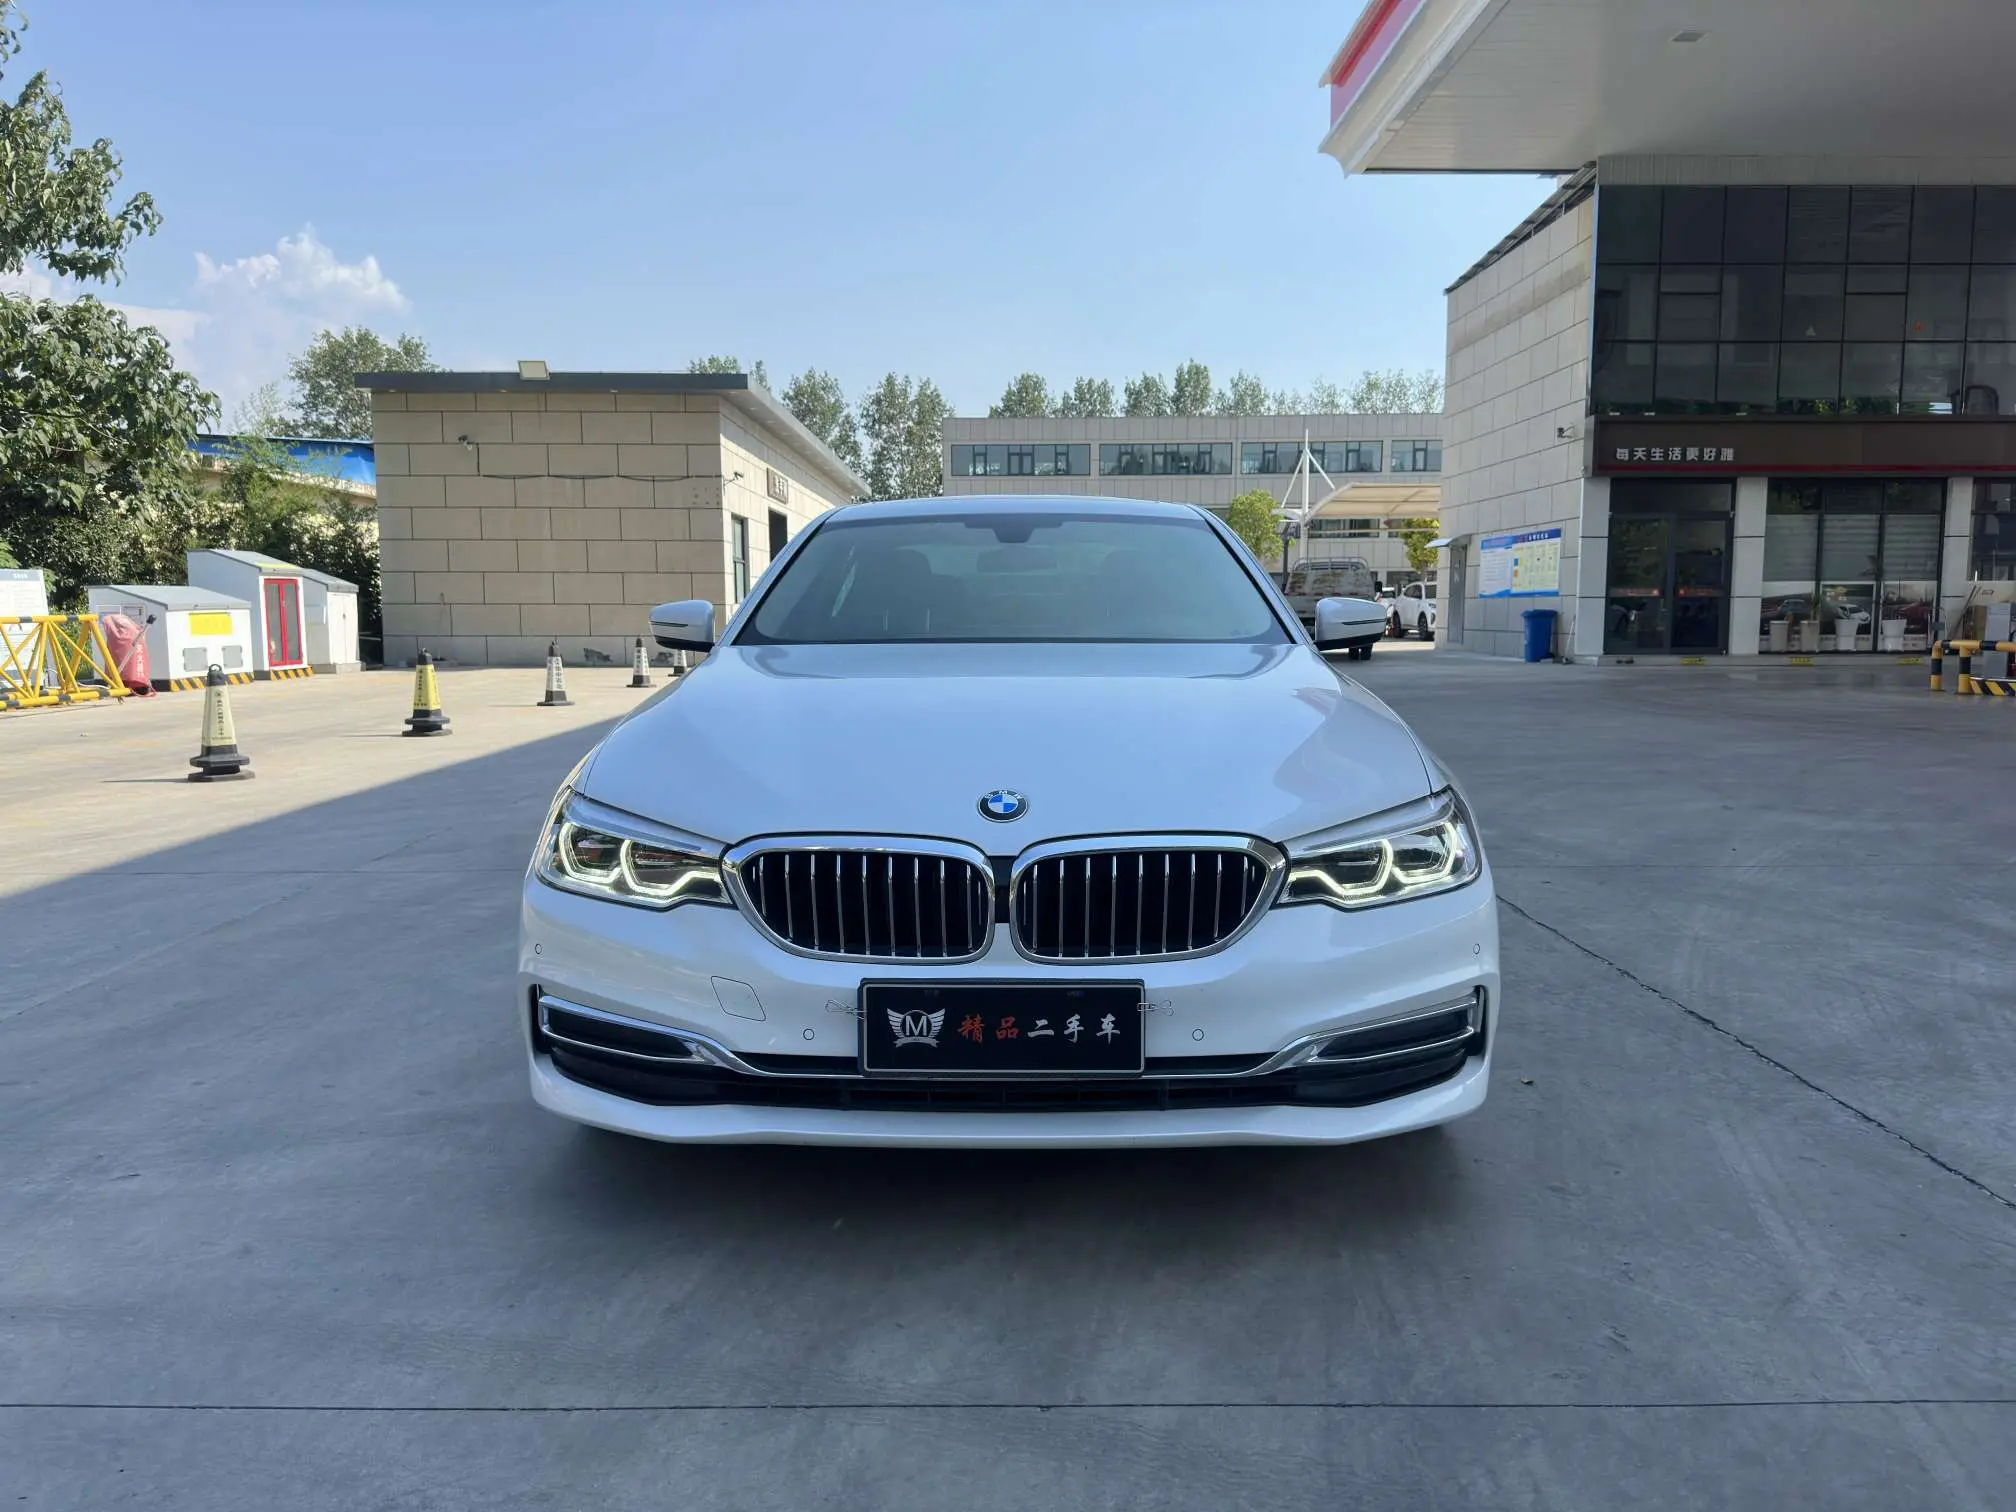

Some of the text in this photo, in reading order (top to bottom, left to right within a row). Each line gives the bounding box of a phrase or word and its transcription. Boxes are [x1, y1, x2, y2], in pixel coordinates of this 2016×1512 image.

[905, 1015, 928, 1036] M
[957, 1013, 1121, 1044] 精品二手车
